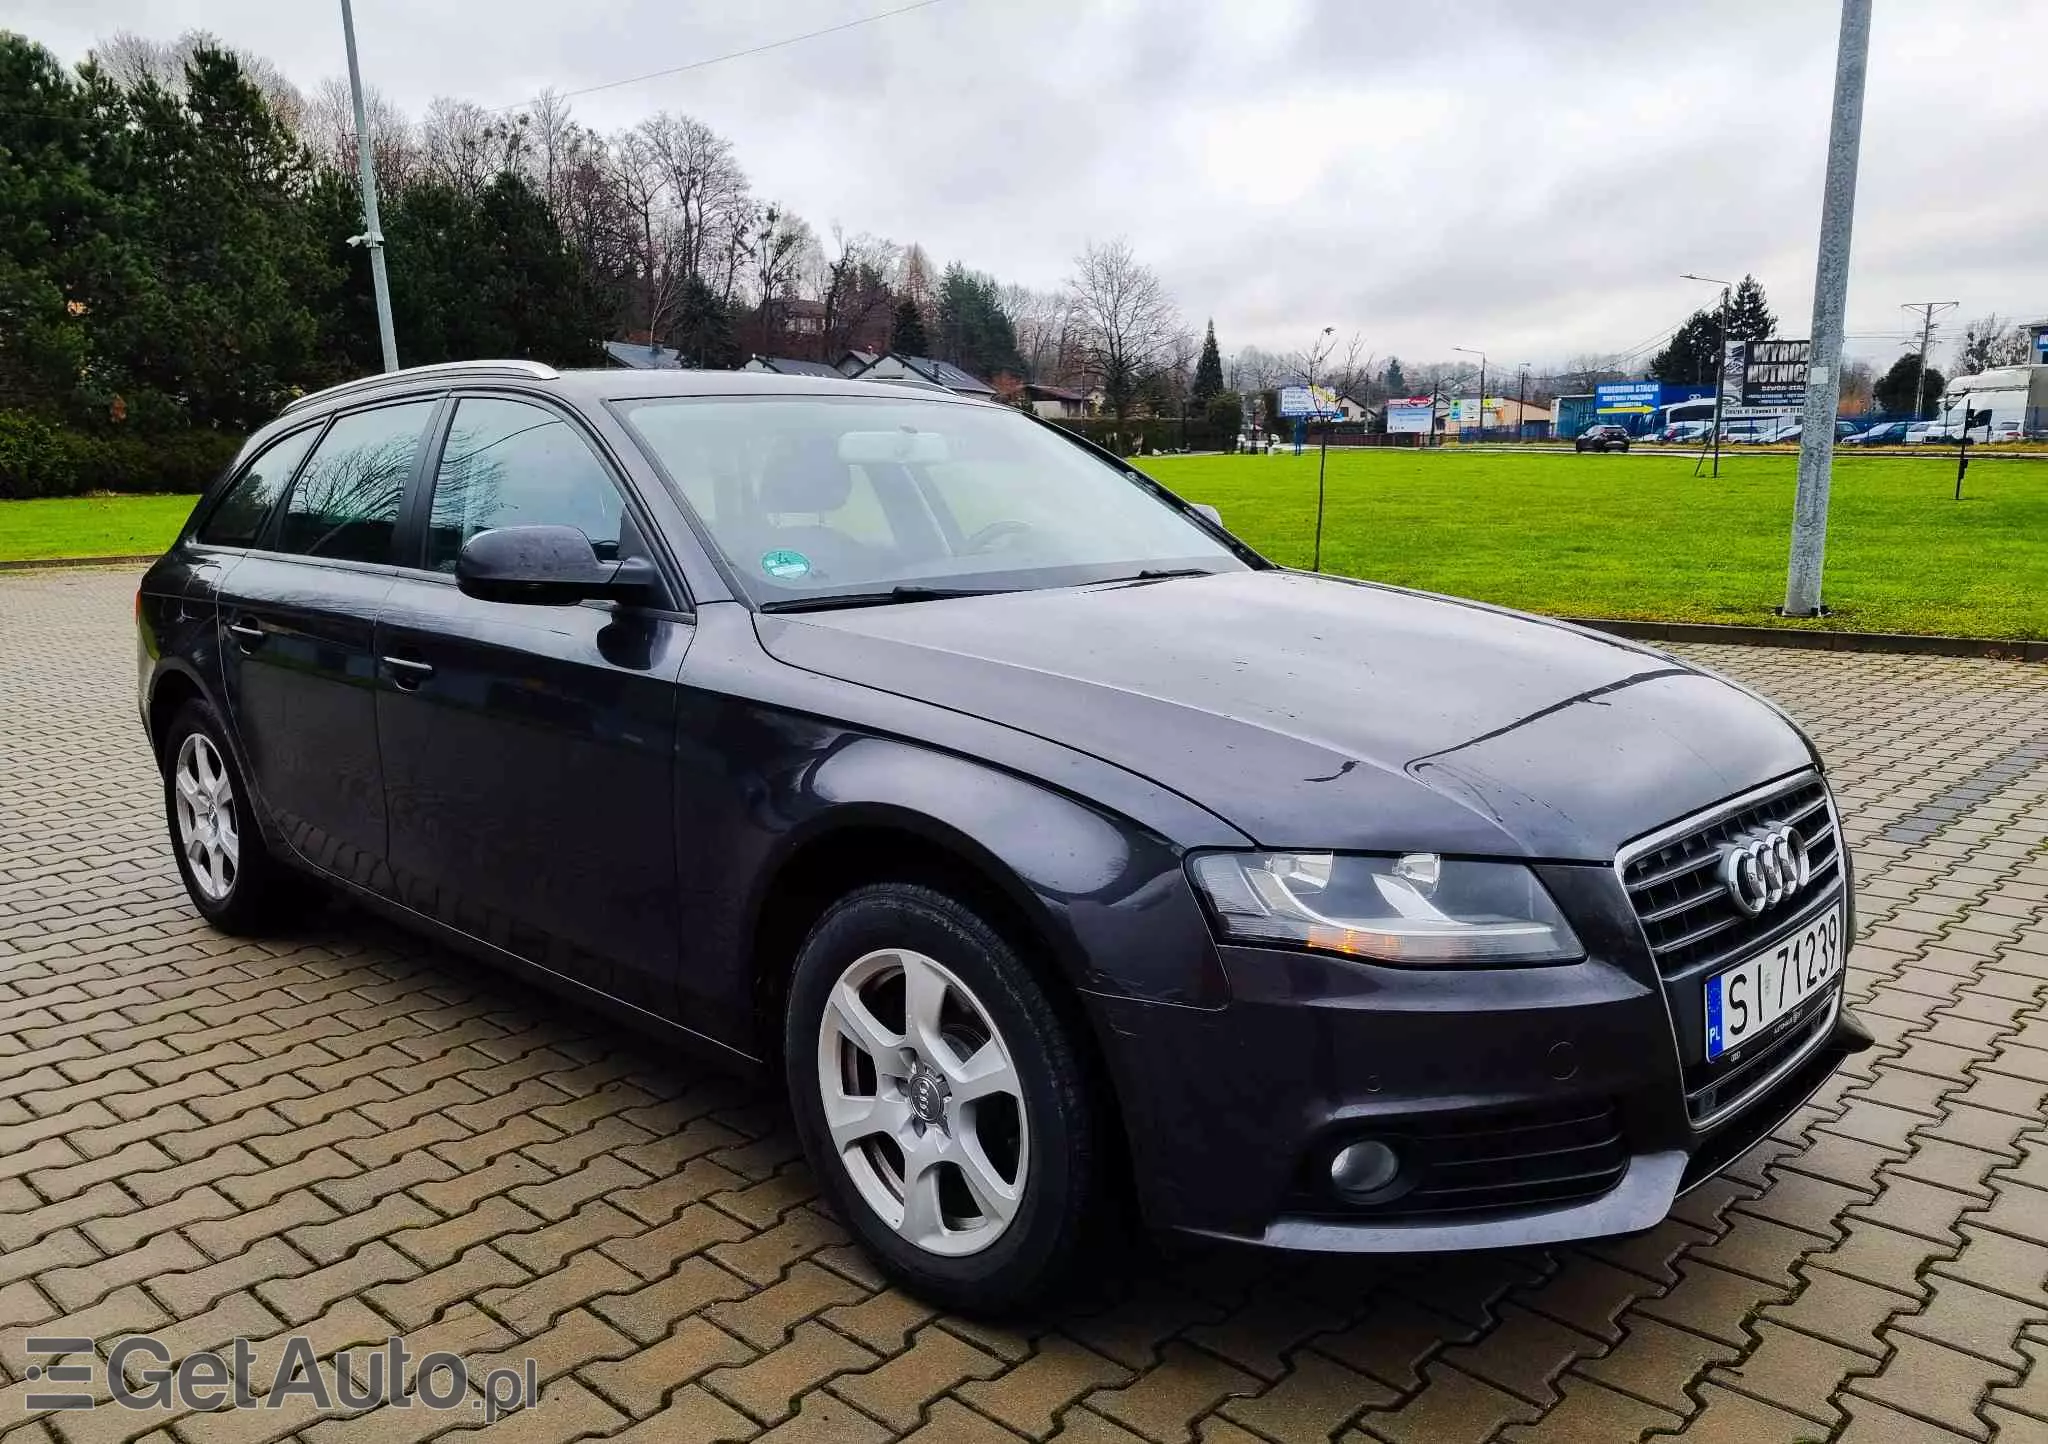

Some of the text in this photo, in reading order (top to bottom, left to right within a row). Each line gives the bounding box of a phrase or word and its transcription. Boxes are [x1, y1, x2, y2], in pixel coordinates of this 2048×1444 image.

[1729, 914, 1838, 1035] SI 71239
[1709, 1025, 1721, 1045] PL
